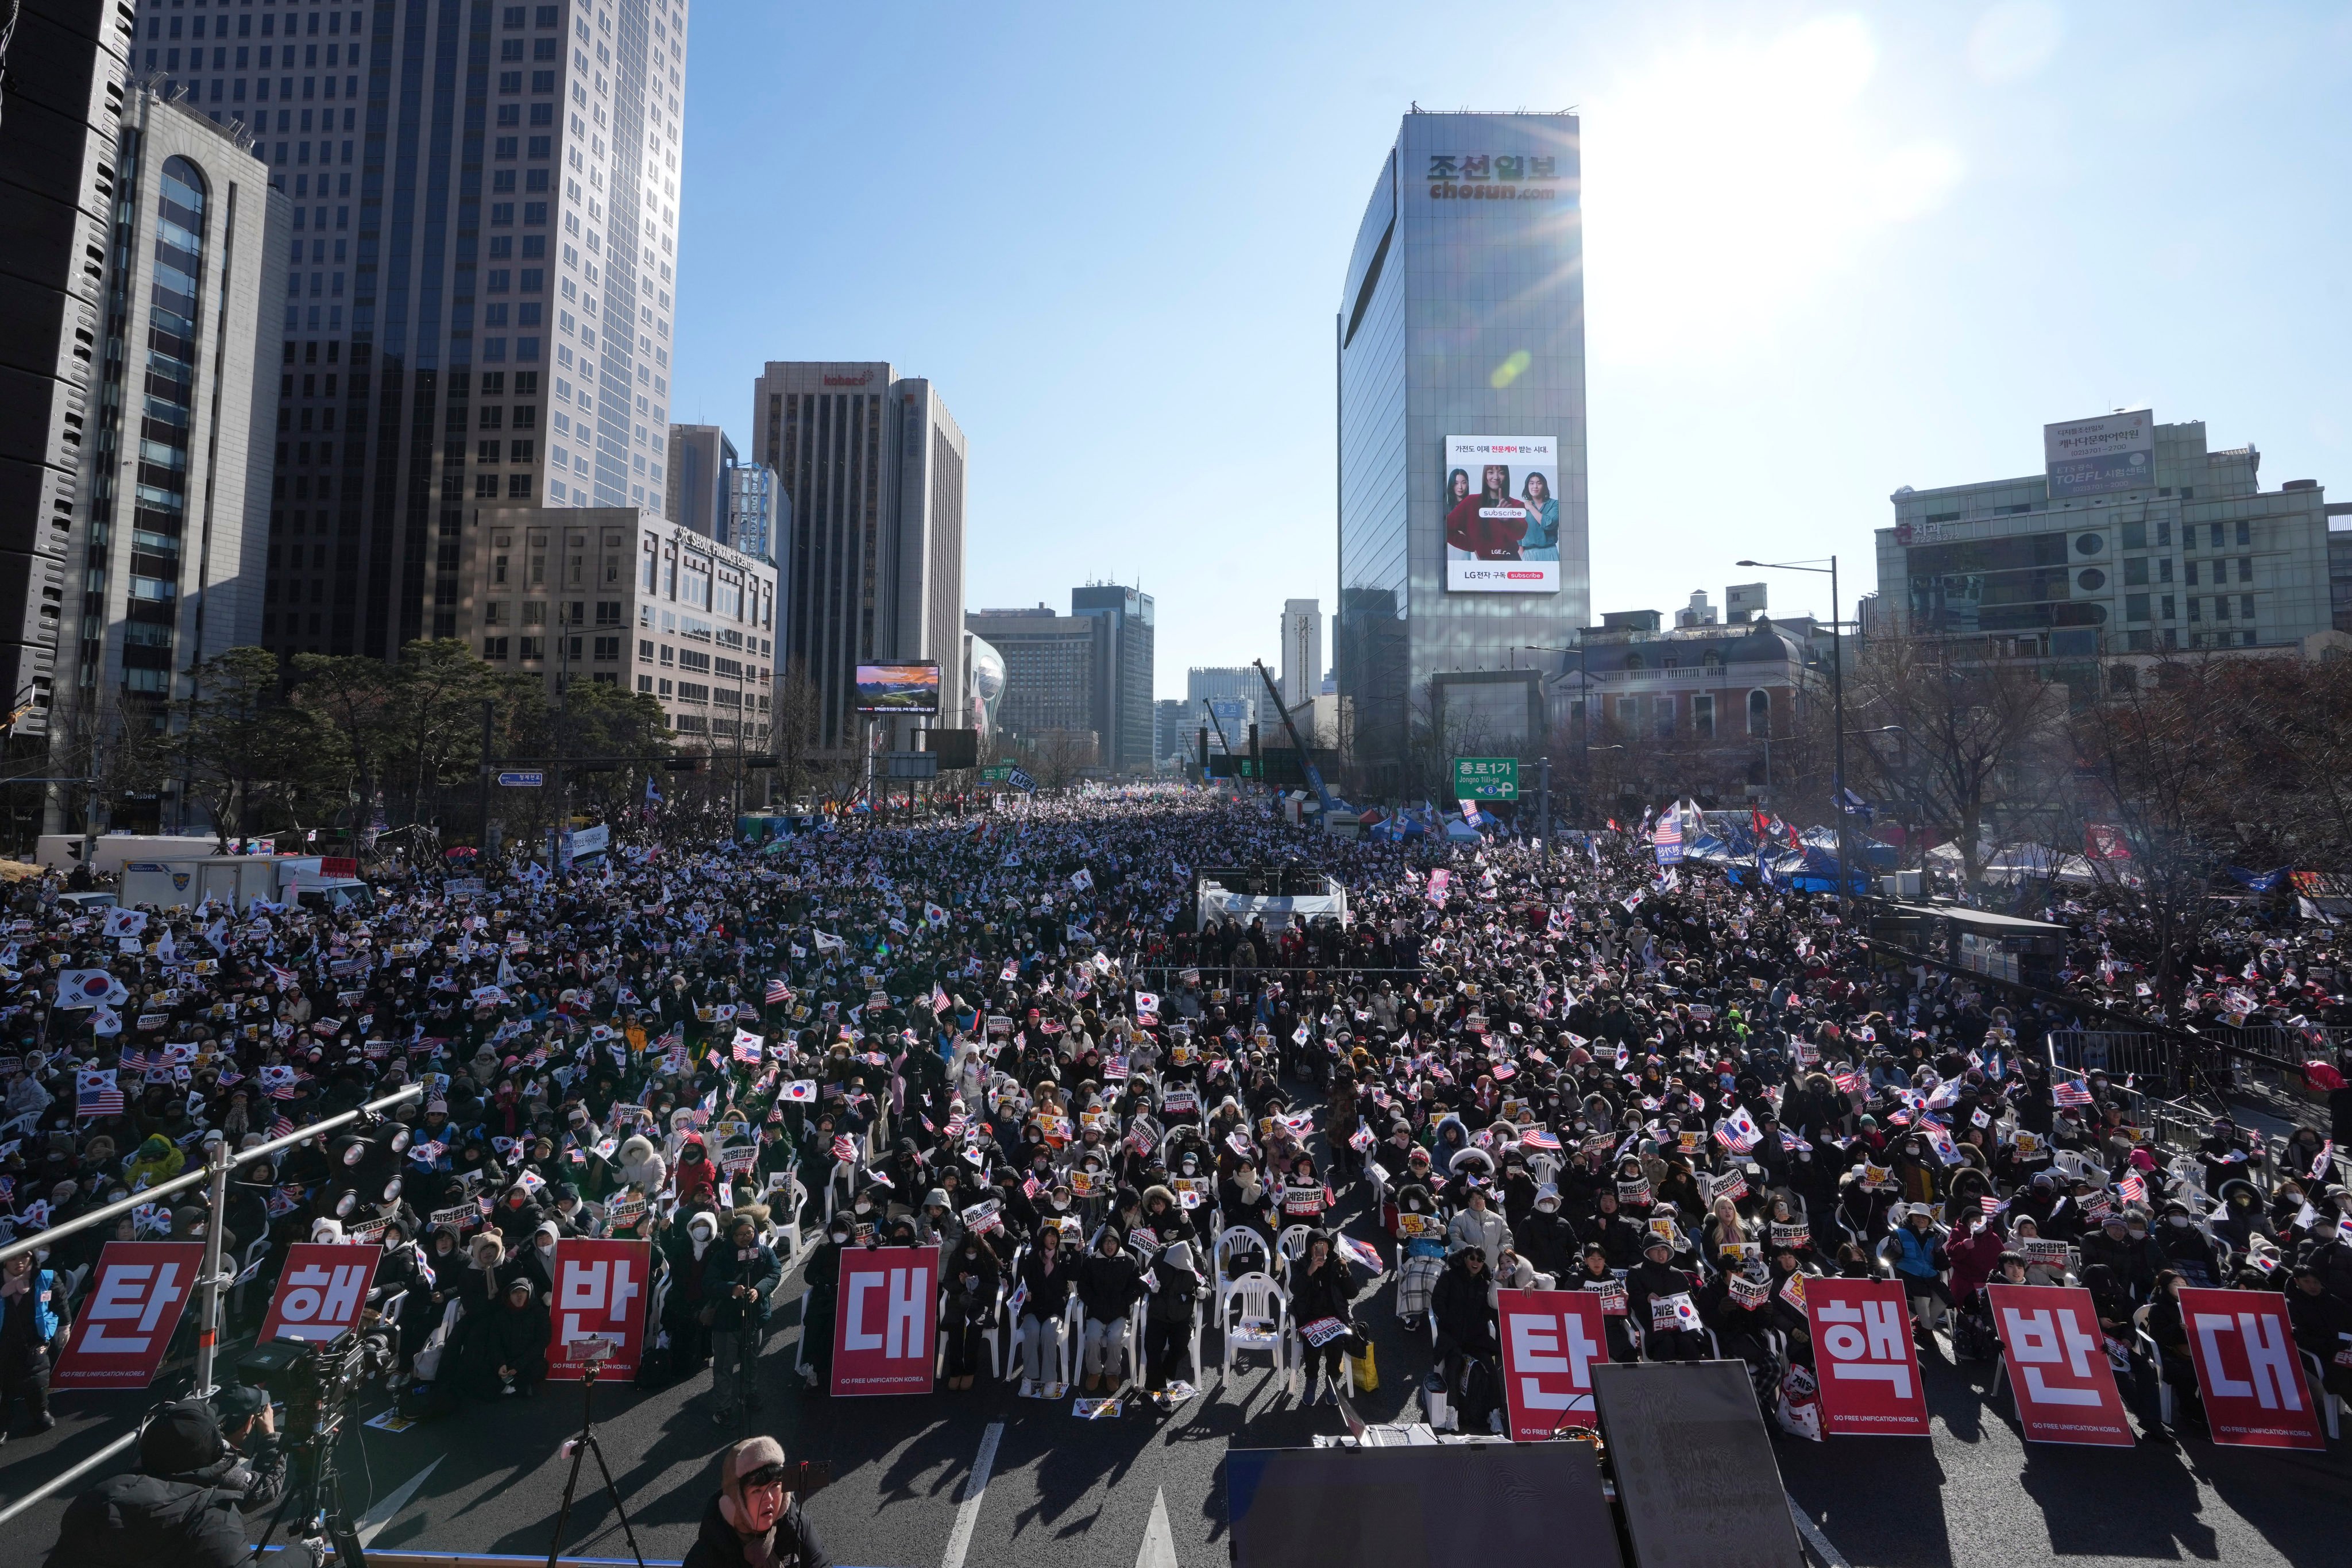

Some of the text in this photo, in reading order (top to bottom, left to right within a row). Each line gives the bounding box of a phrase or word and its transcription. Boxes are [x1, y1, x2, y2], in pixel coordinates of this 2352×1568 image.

[1427, 155, 1560, 180] 조선일보
[1430, 181, 1554, 199] chosun.com
[824, 374, 865, 385] kobaco
[2059, 430, 2139, 448] 캐나다문화어학원
[2072, 444, 2126, 456] (02)3701-2700
[2056, 466, 2146, 485] TOEFL 시험센터
[2073, 481, 2128, 492] (02)3701-2000
[1914, 522, 1941, 536] 치과
[1915, 533, 1960, 543] 722-8272
[1459, 763, 1511, 774] 종로1가
[1459, 776, 1479, 784] Jongno
[139, 1016, 168, 1024] 계엄합법
[1165, 1093, 1194, 1102] 계엄합법
[1165, 1102, 1193, 1111] 탄핵무효
[1131, 1118, 1158, 1145] 계엄합법
[2016, 1136, 2034, 1144] 내란
[2018, 1142, 2036, 1150] 수괴
[721, 1148, 755, 1161] 계엄합법
[2013, 1150, 2029, 1158] 이재명
[1865, 1165, 1883, 1175] 내란
[1710, 1168, 1743, 1195] 계엄합법
[1866, 1173, 1885, 1183] 수괴
[1287, 1189, 1322, 1202] 계엄합법
[432, 1205, 474, 1222] 계엄합법
[1285, 1202, 1320, 1214] 탄핵무효
[1401, 1216, 1419, 1225] 내란
[1652, 1220, 1670, 1230] 내란
[1407, 1224, 1424, 1233] 수괴
[1771, 1226, 1810, 1237] 계엄합법
[1723, 1245, 1740, 1254] 내란
[2025, 1241, 2067, 1254] 계엄합법
[1731, 1276, 1772, 1296] 계엄합법
[78, 1263, 181, 1353] 탄
[560, 1261, 638, 1347] 반
[1654, 1303, 1674, 1316] 계엄
[845, 1268, 928, 1358] 대
[1817, 1300, 1913, 1399] 핵
[1509, 1314, 1598, 1411] 탄
[2003, 1308, 2103, 1407] 반
[2194, 1312, 2303, 1411] 대
